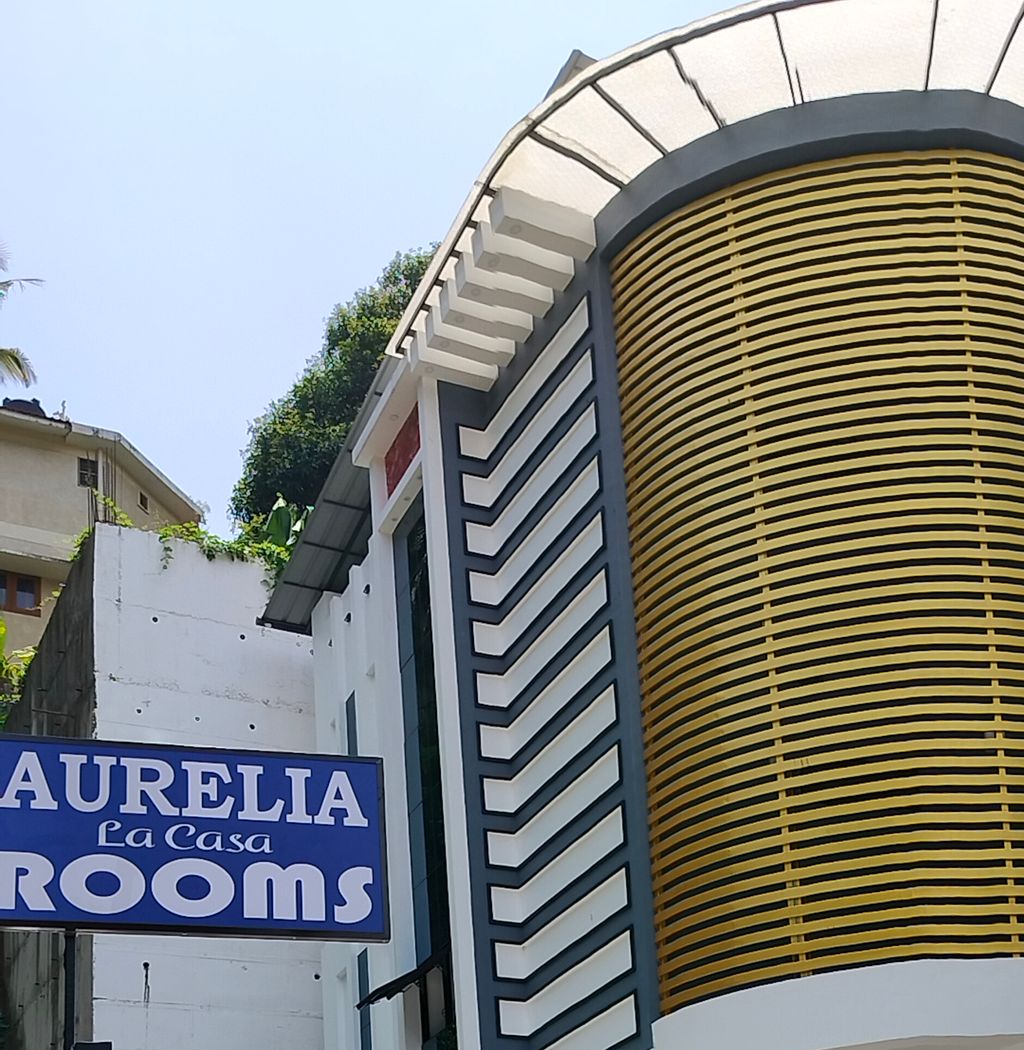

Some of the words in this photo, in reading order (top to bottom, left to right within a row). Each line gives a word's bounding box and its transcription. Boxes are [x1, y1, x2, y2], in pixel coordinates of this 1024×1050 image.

[0, 751, 369, 827] AURELIA
[97, 819, 155, 848] La
[164, 823, 273, 853] Casa
